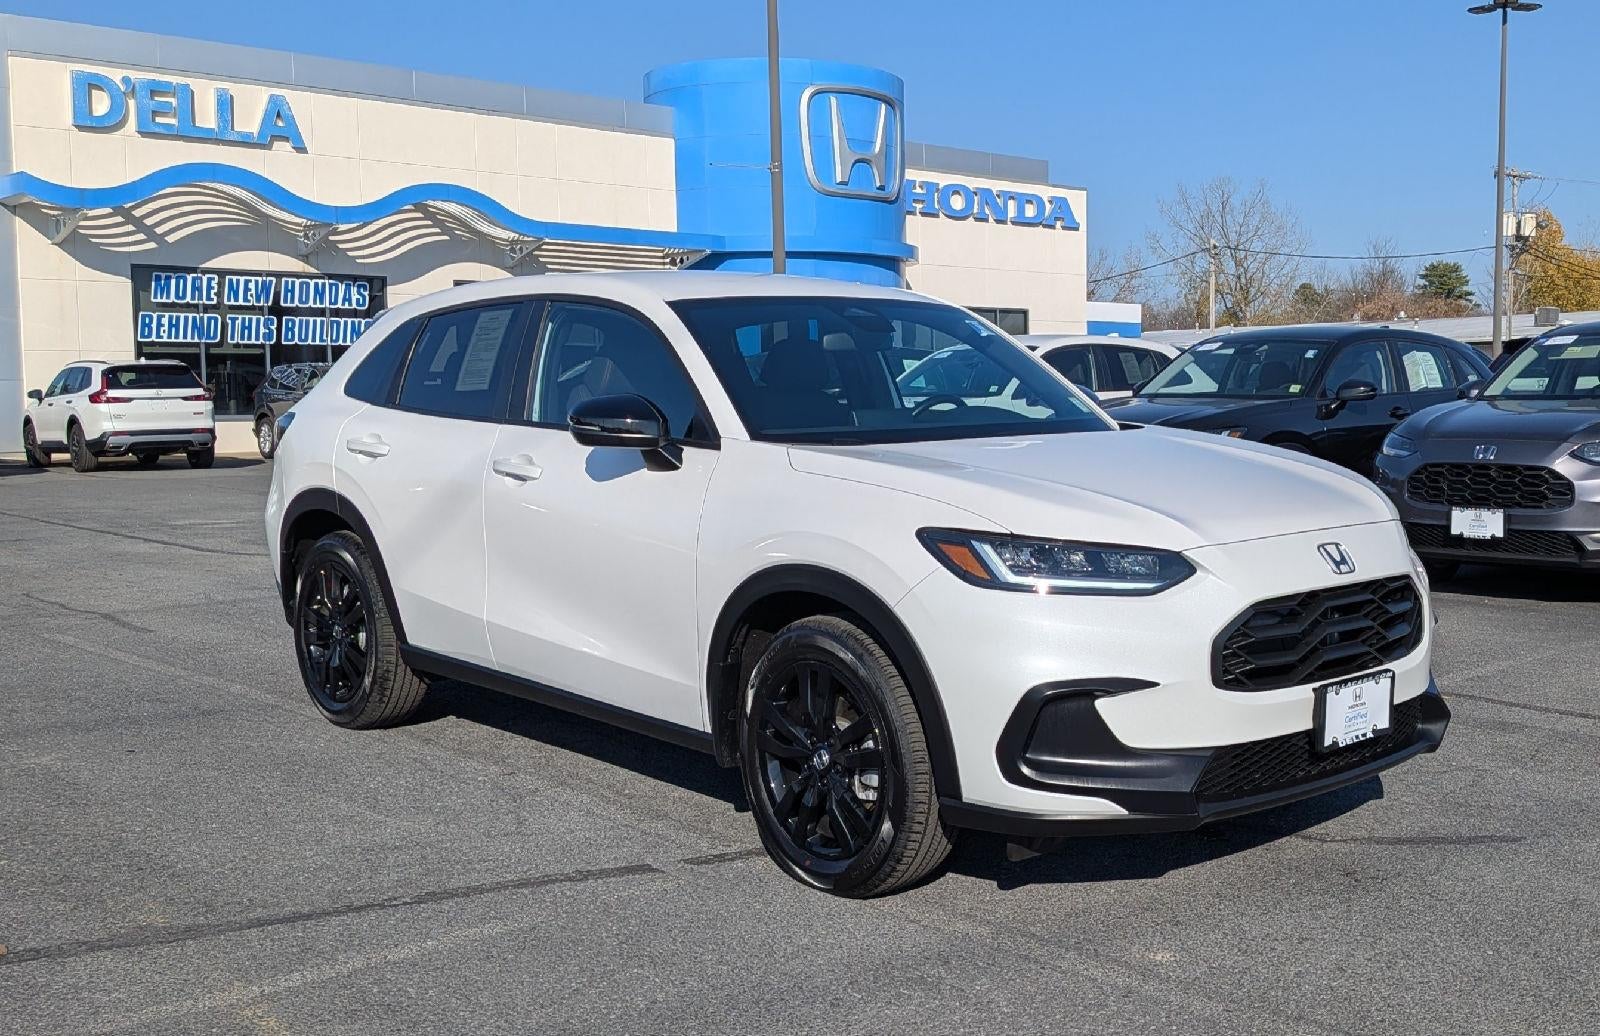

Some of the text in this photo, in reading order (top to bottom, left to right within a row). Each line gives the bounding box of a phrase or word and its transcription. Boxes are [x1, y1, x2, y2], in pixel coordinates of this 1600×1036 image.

[71, 69, 307, 150] D'ELLA
[906, 178, 1080, 231] HONDA
[152, 272, 369, 309] MORE NEW HONDAS
[138, 312, 221, 342] BEHIND
[227, 314, 277, 344] THIS
[1345, 711, 1368, 723] Certified
